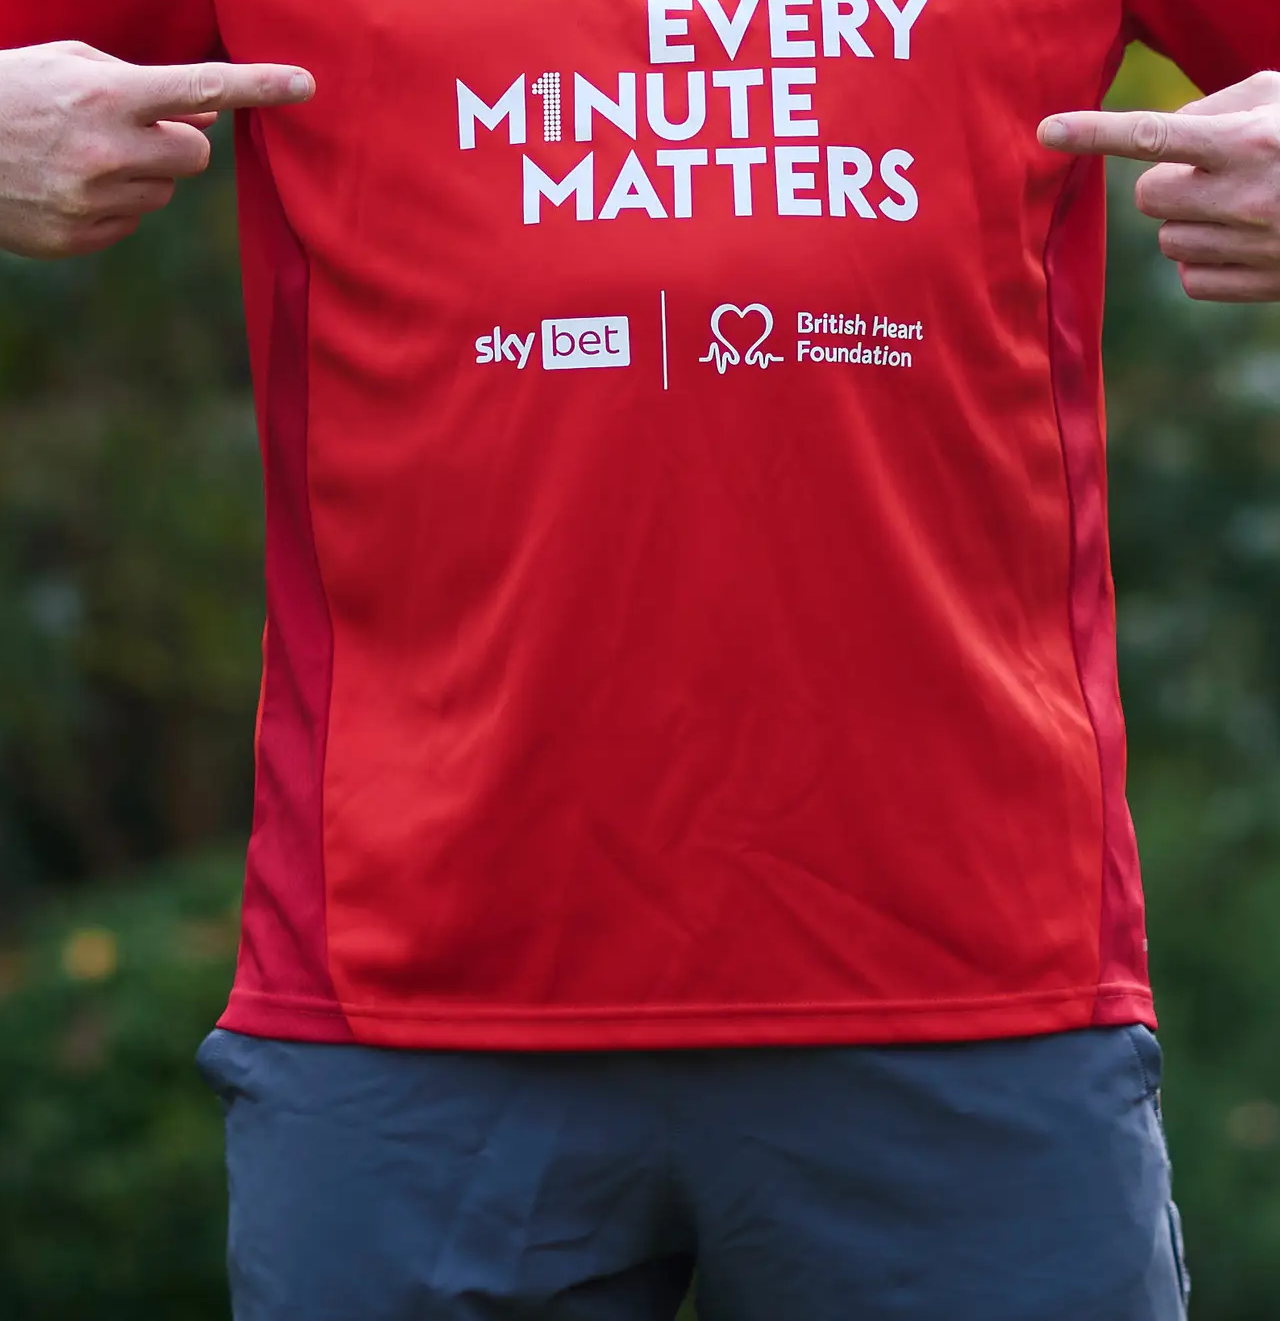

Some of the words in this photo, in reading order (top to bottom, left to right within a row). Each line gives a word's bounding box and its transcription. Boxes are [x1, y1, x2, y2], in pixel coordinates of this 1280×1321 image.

[522, 146, 920, 225] MATTERS
[797, 311, 867, 336] British
[872, 315, 924, 340] Heart
[475, 325, 536, 369] sky
[551, 324, 620, 357] bet
[797, 340, 912, 368] Foundation
